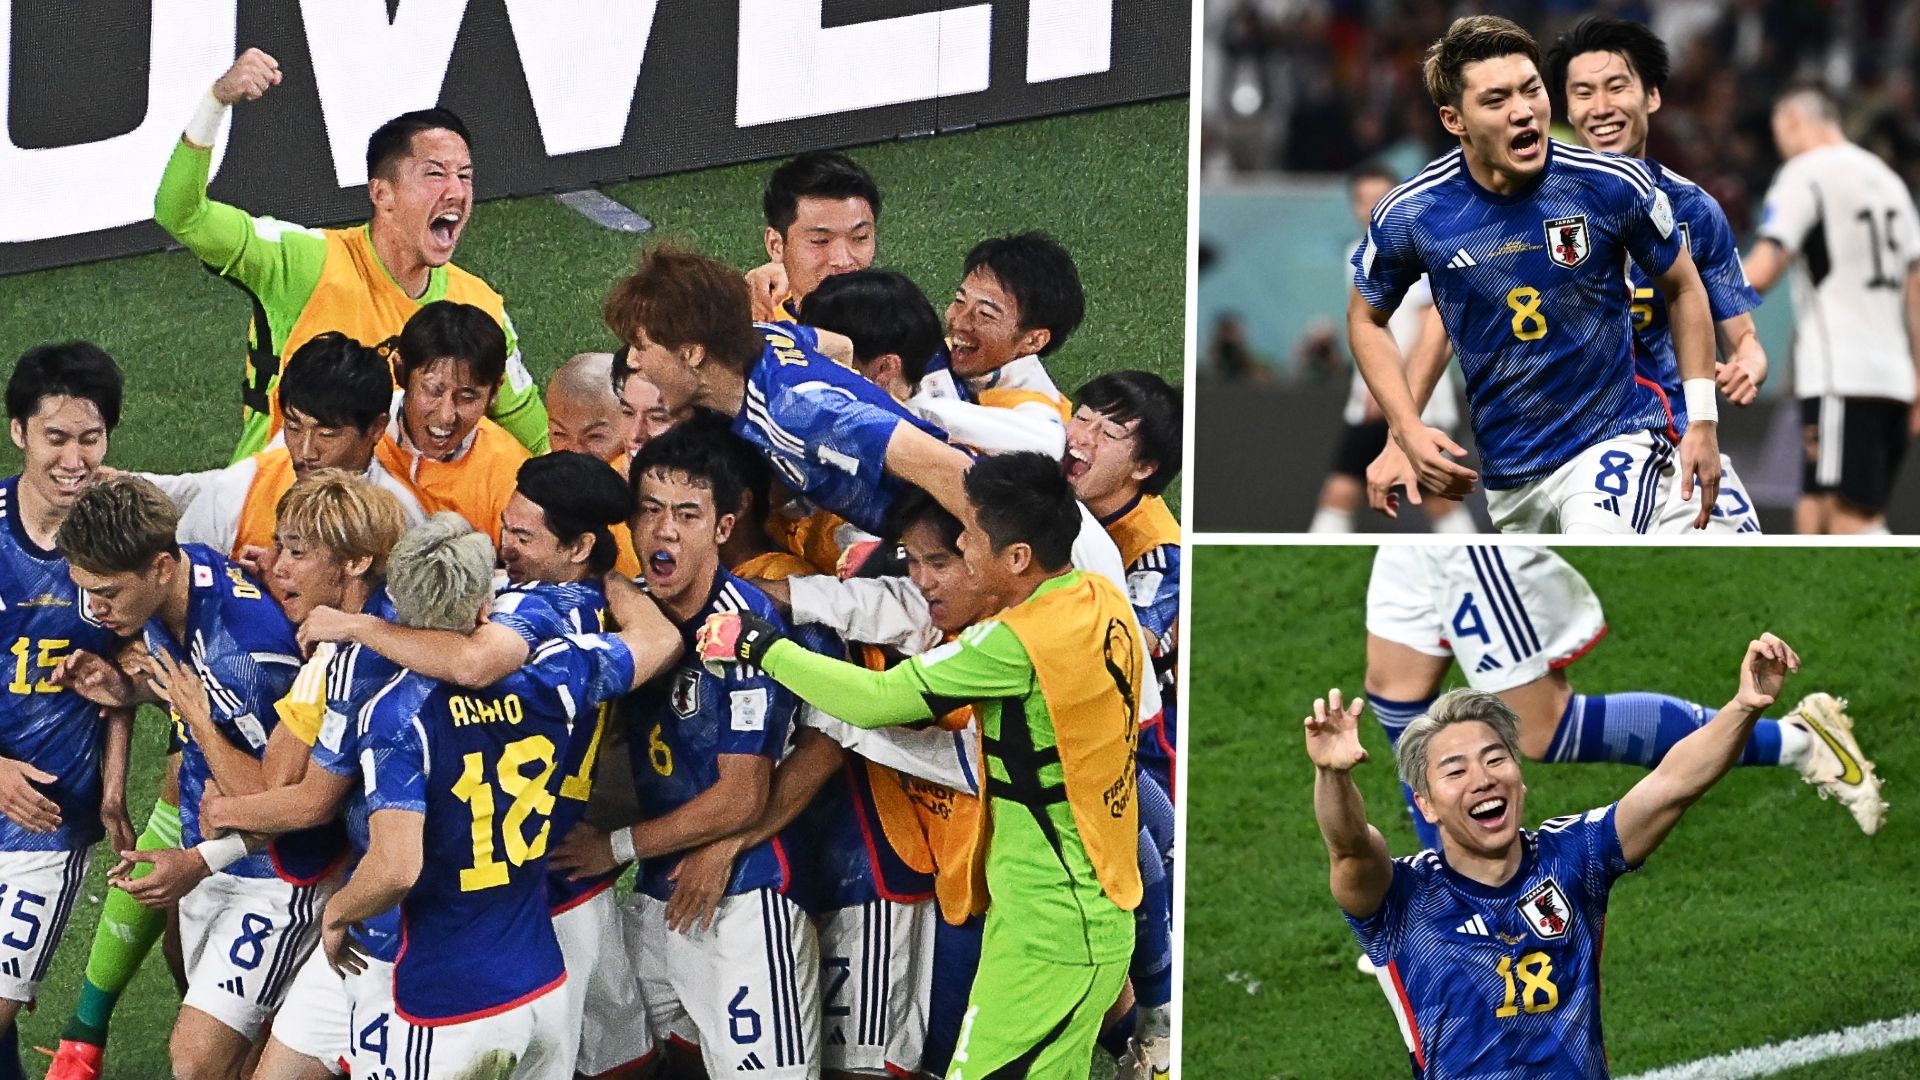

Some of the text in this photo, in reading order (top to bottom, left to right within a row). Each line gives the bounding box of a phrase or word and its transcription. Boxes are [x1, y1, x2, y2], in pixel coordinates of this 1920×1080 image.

[1507, 286, 1548, 341] 8
[1595, 450, 1634, 497] 8
[1452, 592, 1492, 645] 4
[9, 637, 70, 694] 15
[649, 723, 673, 777] 6
[451, 735, 559, 892] 18
[1525, 886, 1546, 902] JAPAN
[229, 912, 274, 970] 8
[1496, 951, 1559, 1018] 18
[728, 986, 762, 1044] 6
